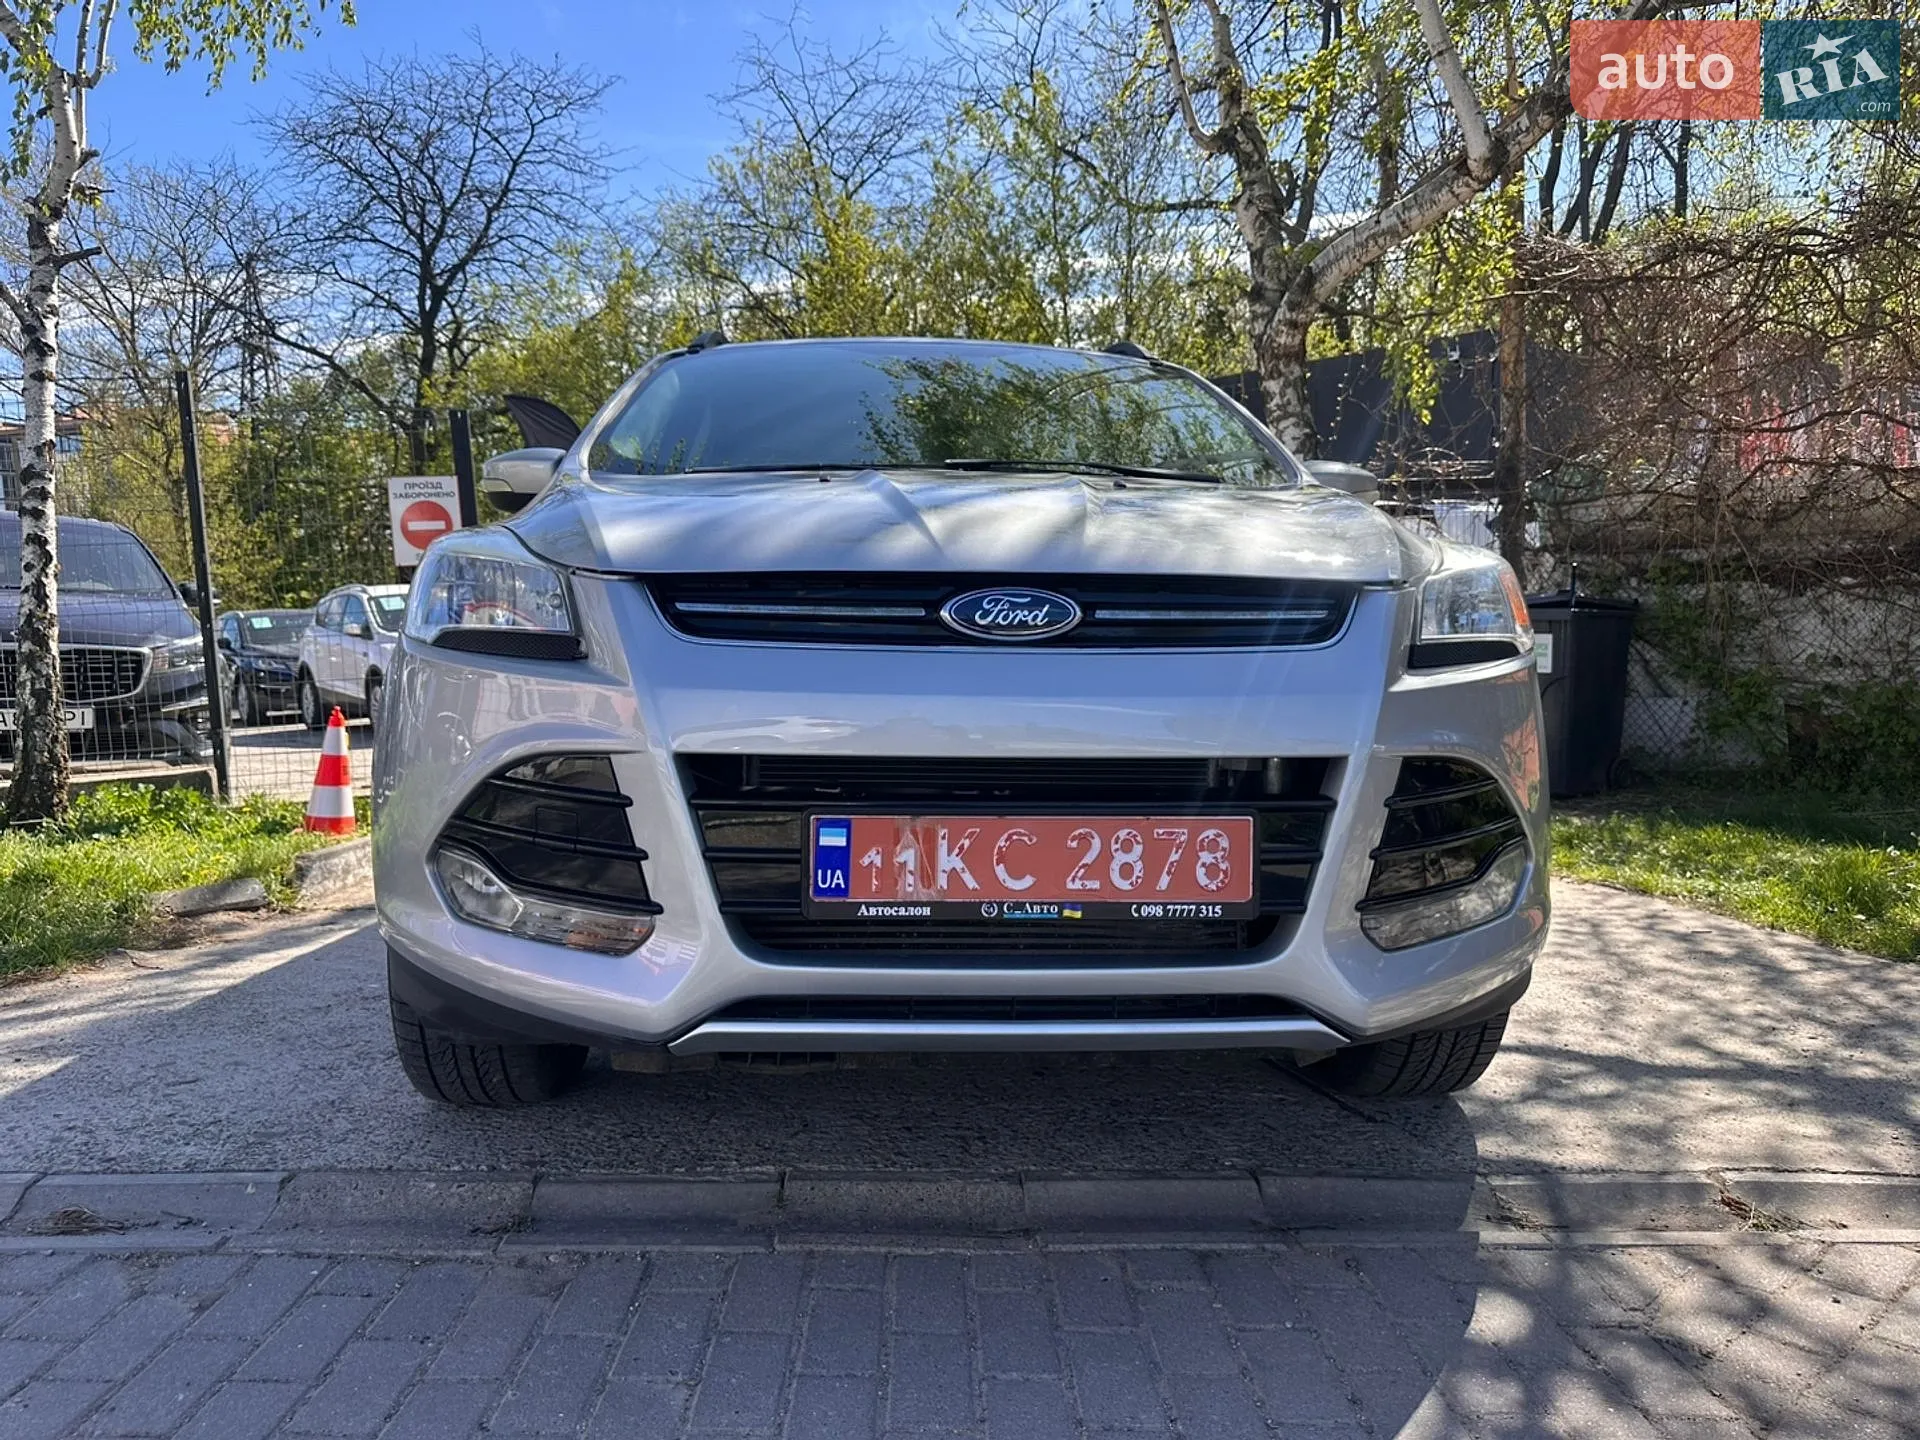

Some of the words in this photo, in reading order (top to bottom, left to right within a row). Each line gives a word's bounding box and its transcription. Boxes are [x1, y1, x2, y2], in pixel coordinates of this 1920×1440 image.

[403, 481, 443, 490] ПРОЇЗД
[392, 491, 456, 499] ЗАБОРОНЕНО
[974, 595, 1050, 626] Ford
[1066, 828, 1231, 892] 2878
[817, 869, 845, 889] UA
[857, 904, 932, 917] Автосалон
[1141, 904, 1163, 917] 098
[1166, 905, 1196, 917] 7777
[1199, 905, 1222, 917] 315
